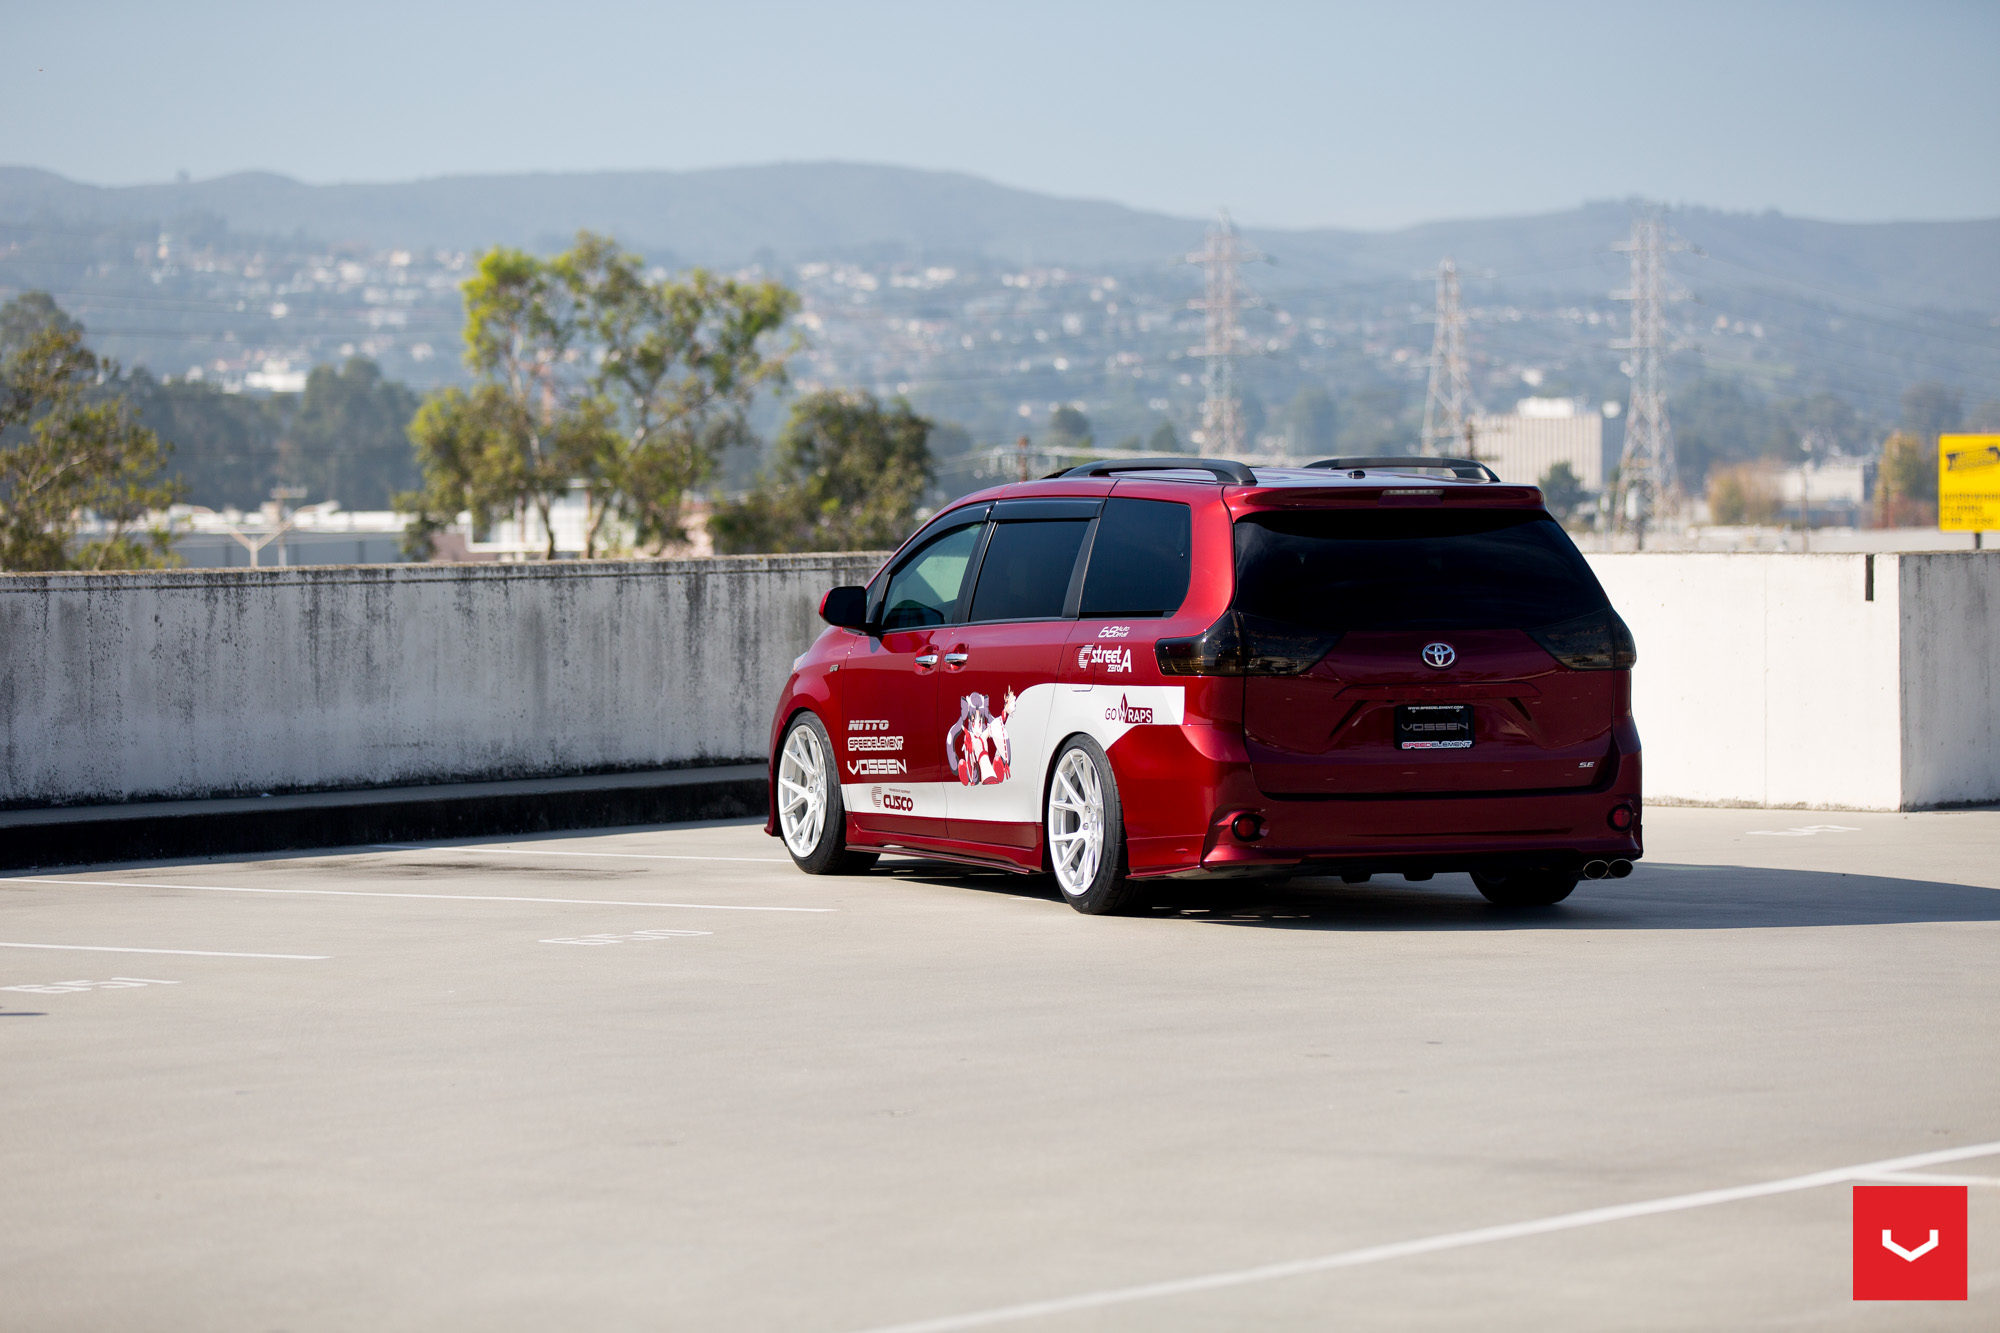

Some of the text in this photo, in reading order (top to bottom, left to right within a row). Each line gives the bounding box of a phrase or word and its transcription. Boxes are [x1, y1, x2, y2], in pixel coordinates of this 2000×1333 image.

[1098, 626, 1117, 638] 68
[1090, 645, 1132, 673] street A
[1105, 707, 1117, 721] GO
[848, 720, 890, 731] NITTO
[1401, 722, 1469, 731] VOSSEN
[847, 758, 908, 776] VOSSEN
[883, 794, 914, 812] CUSCO
